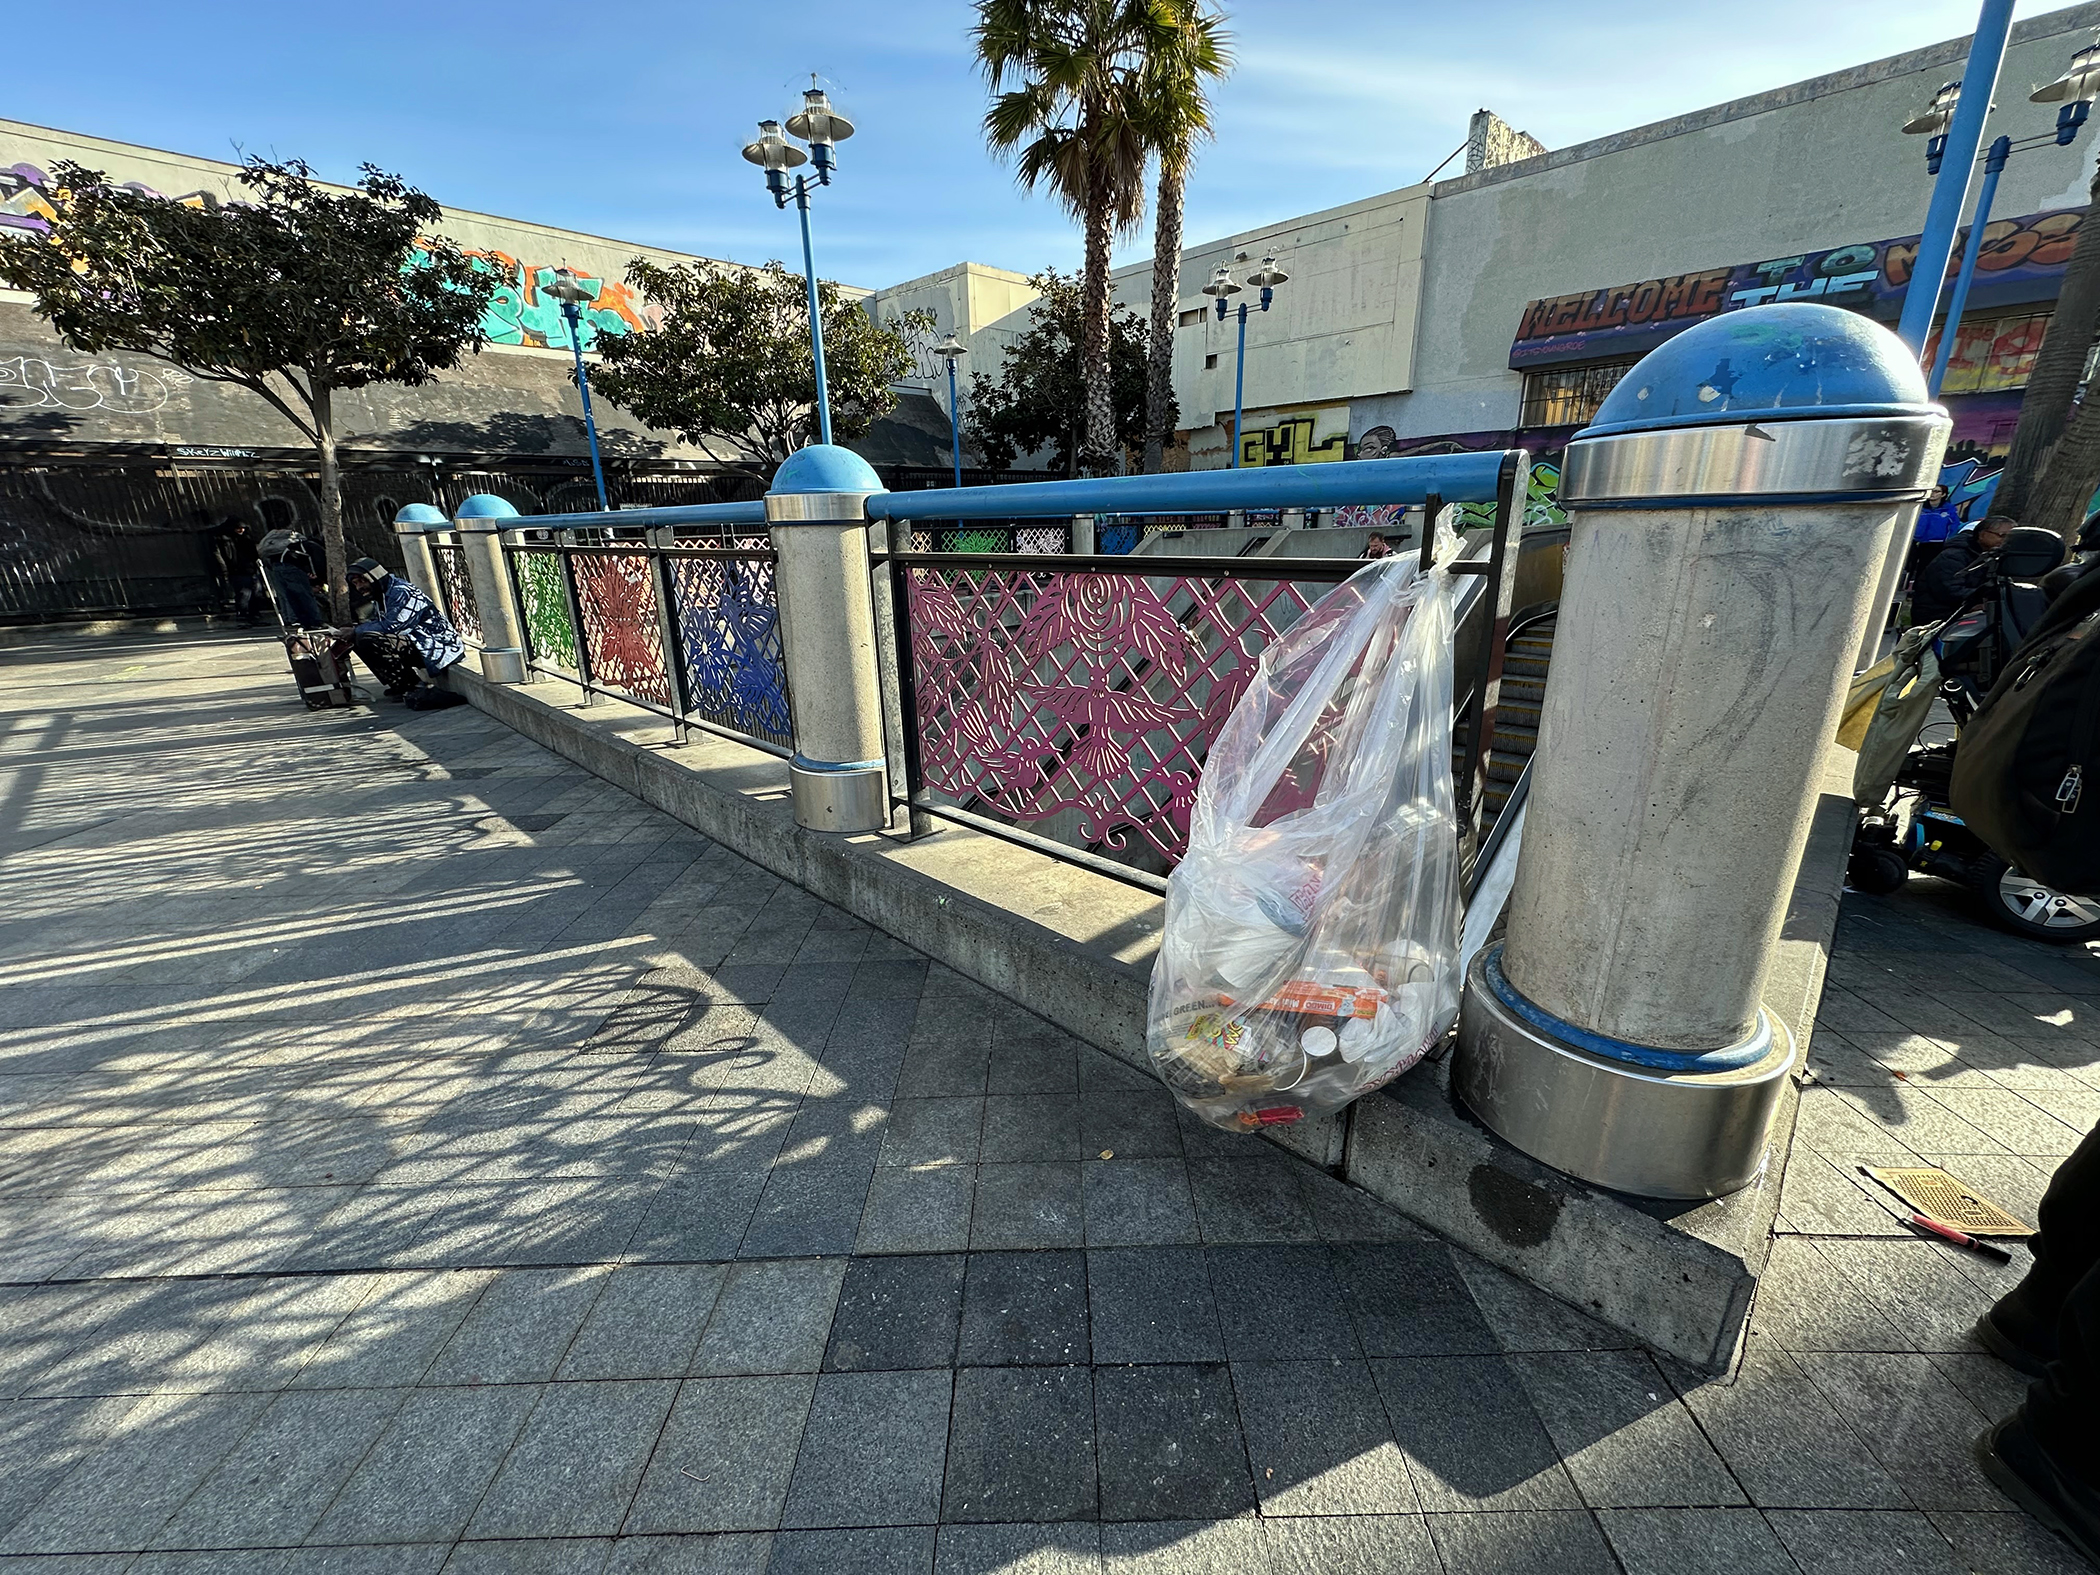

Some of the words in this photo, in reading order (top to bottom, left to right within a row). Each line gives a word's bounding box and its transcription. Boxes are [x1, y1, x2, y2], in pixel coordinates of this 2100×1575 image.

[1514, 266, 1735, 341] WELCOME
[1755, 244, 1877, 286] TO
[1730, 269, 1880, 308] THE
